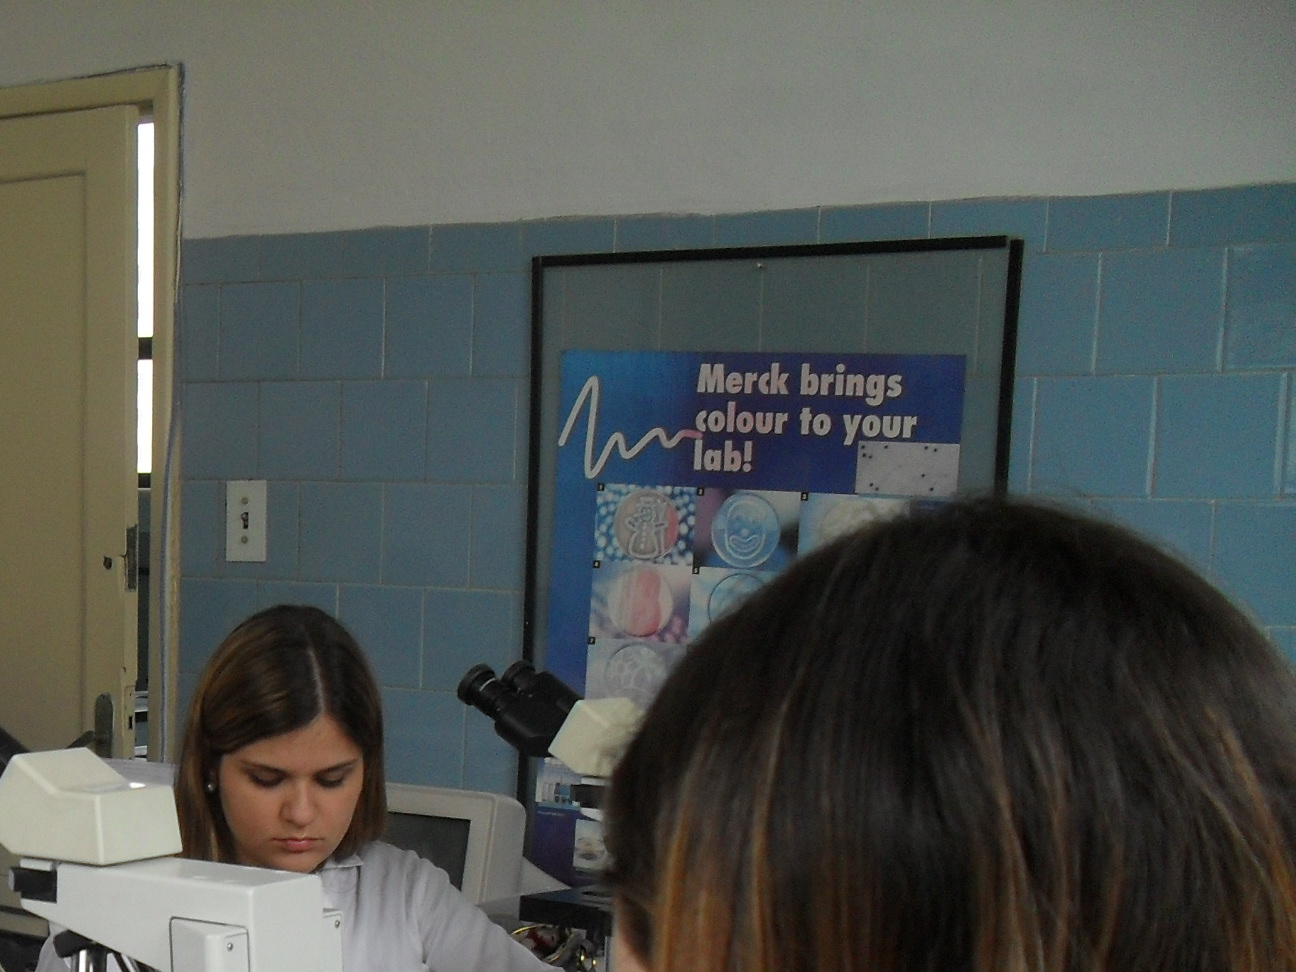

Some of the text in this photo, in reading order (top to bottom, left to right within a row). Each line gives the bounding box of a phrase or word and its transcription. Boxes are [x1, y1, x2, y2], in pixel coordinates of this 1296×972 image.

[697, 363, 902, 406] Merck brings
[695, 401, 917, 446] colour to your
[694, 439, 753, 473] lab!
